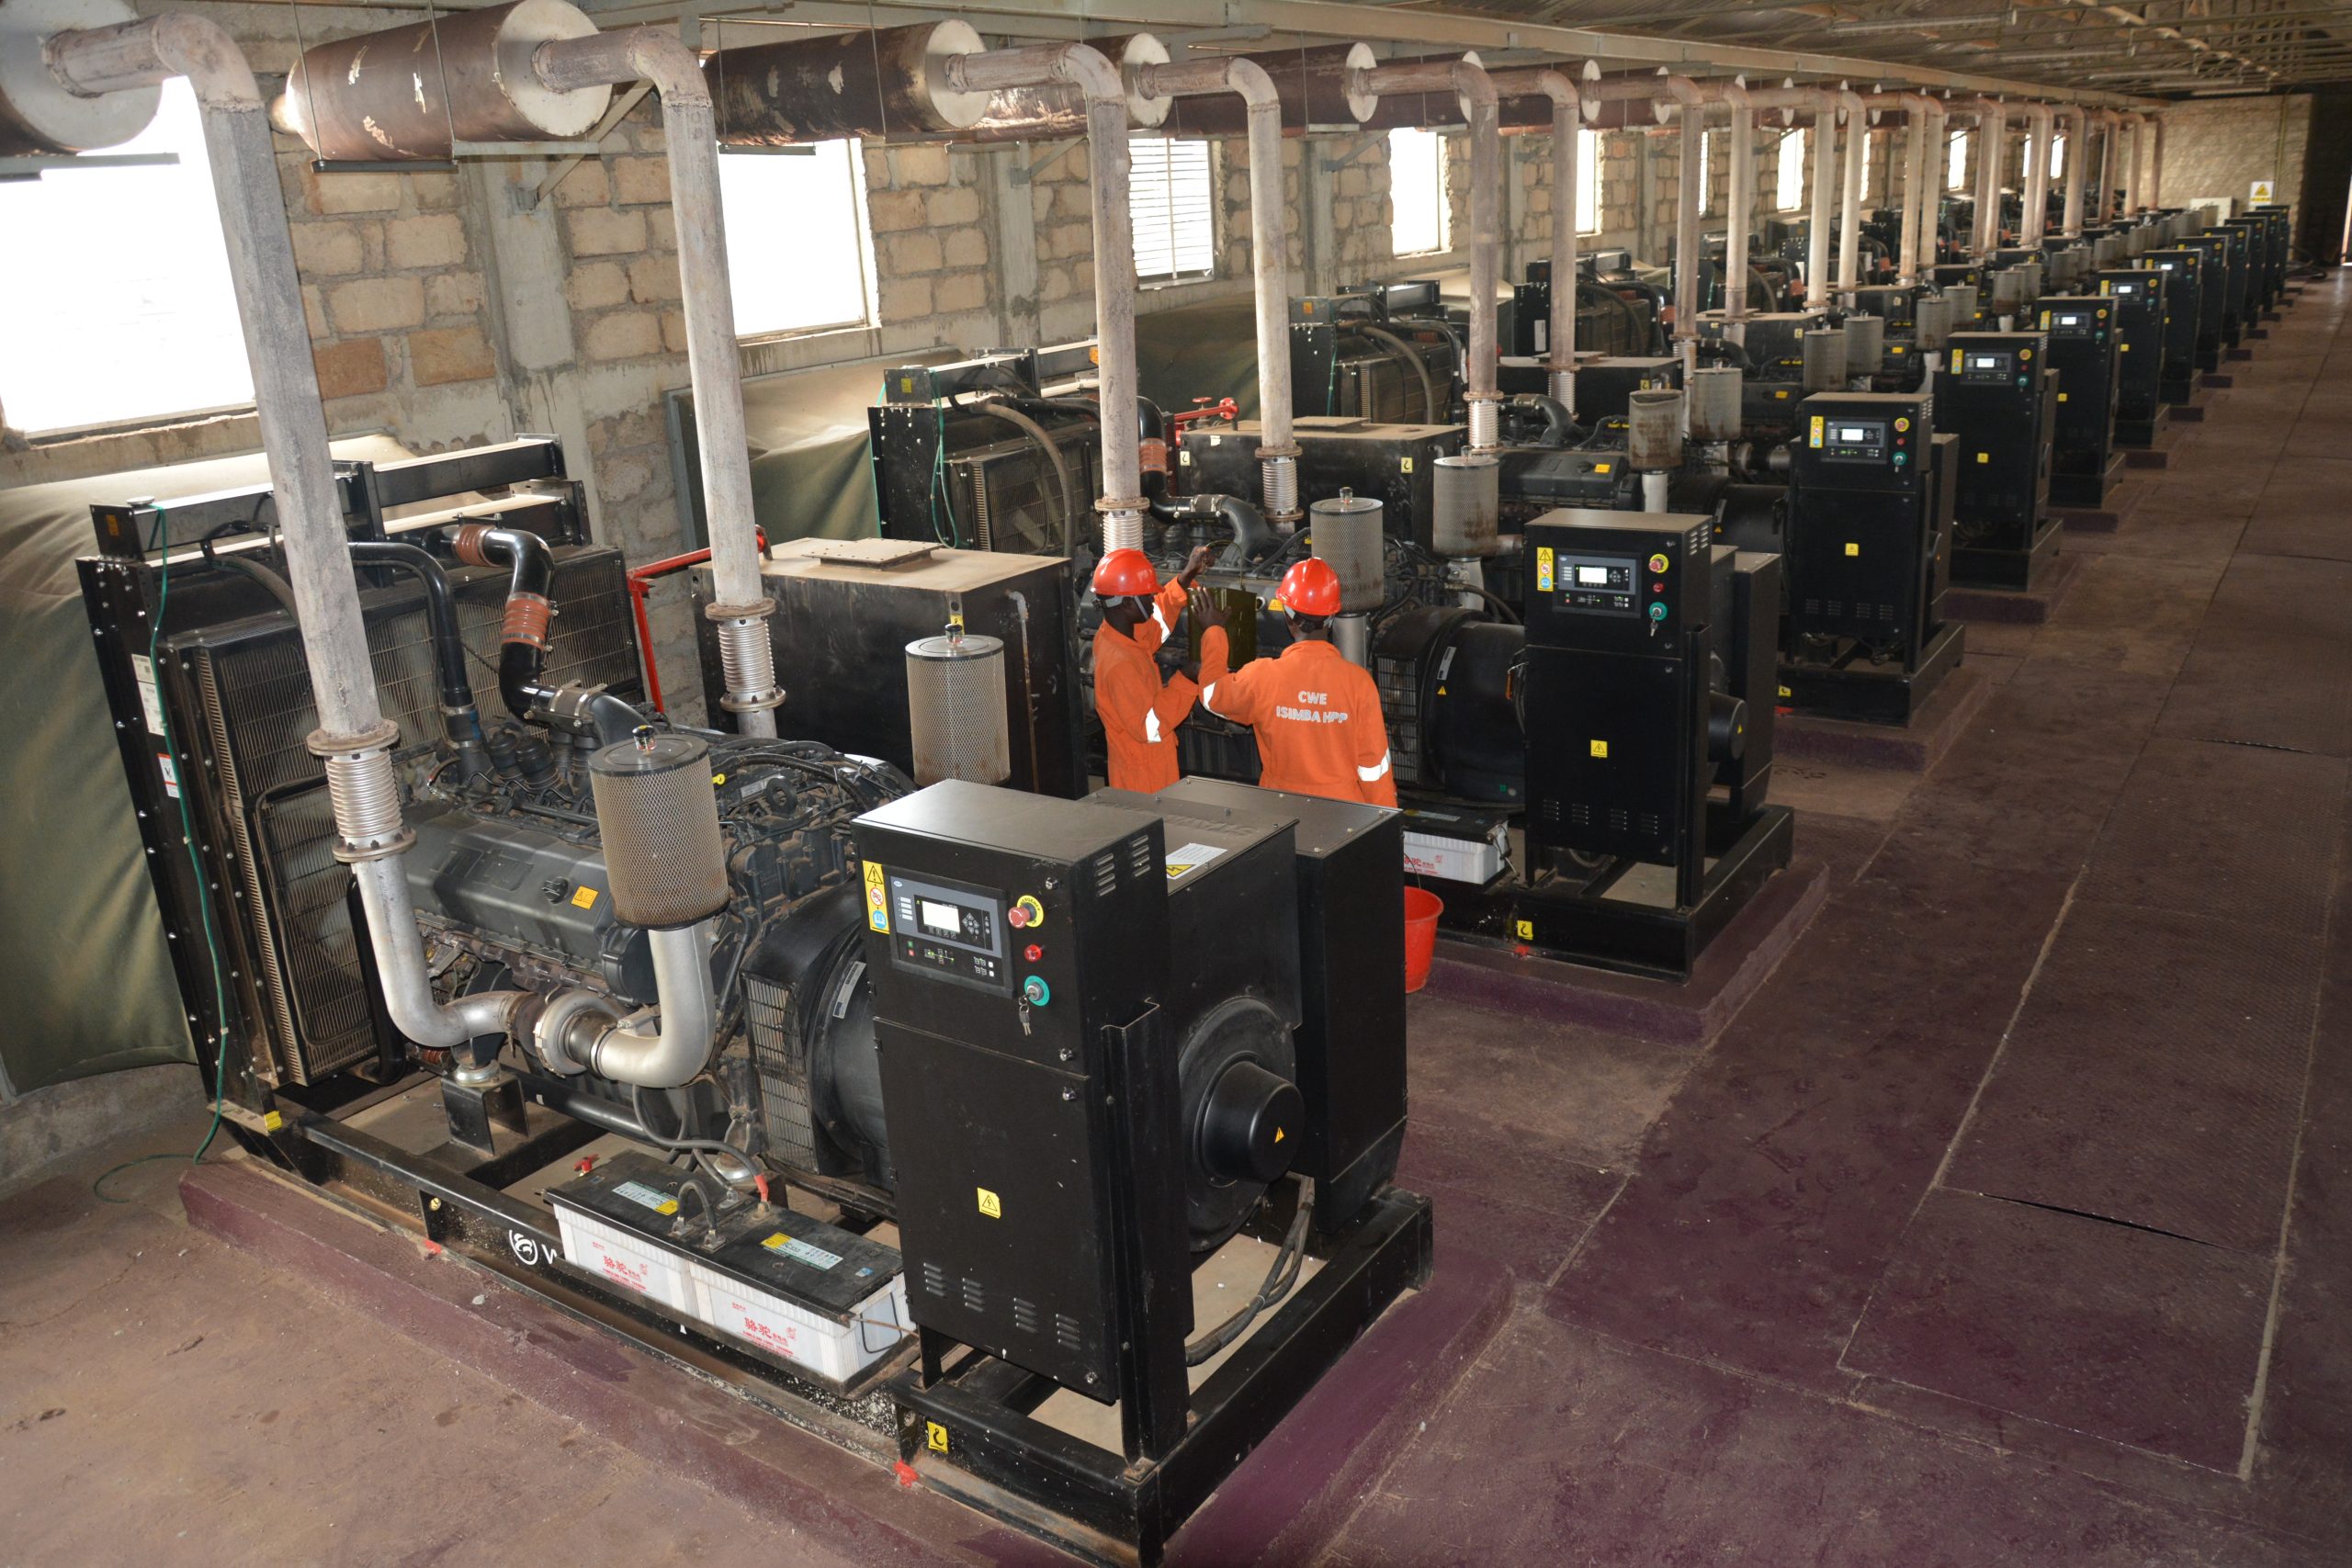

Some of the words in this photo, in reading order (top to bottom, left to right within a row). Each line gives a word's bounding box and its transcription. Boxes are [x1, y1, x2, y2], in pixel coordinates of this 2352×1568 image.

[1298, 691, 1328, 705] CWE
[1276, 705, 1321, 723] ISIMBA
[1323, 712, 1348, 724] HPP
